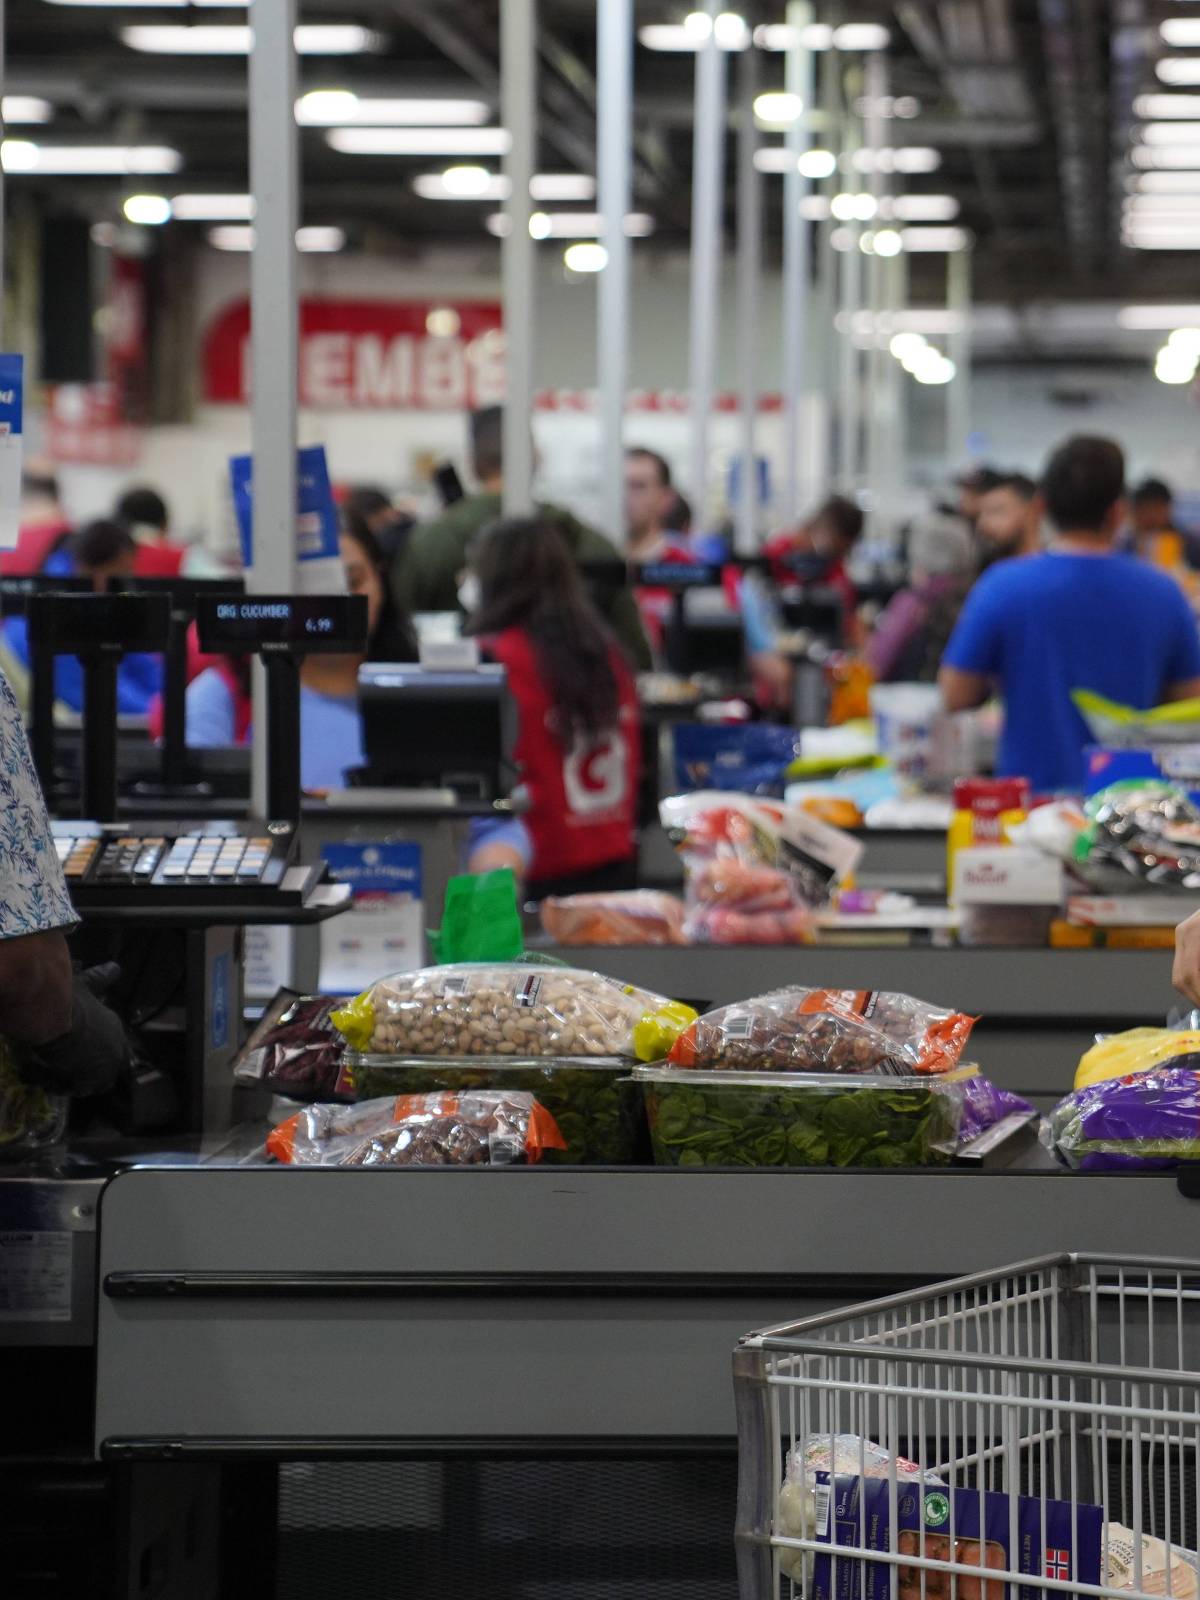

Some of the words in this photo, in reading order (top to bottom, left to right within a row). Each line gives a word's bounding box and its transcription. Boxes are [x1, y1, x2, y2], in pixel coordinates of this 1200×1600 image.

[239, 332, 507, 405] EMBE
[217, 604, 236, 618] ORG
[240, 604, 289, 618] CUCUMBER
